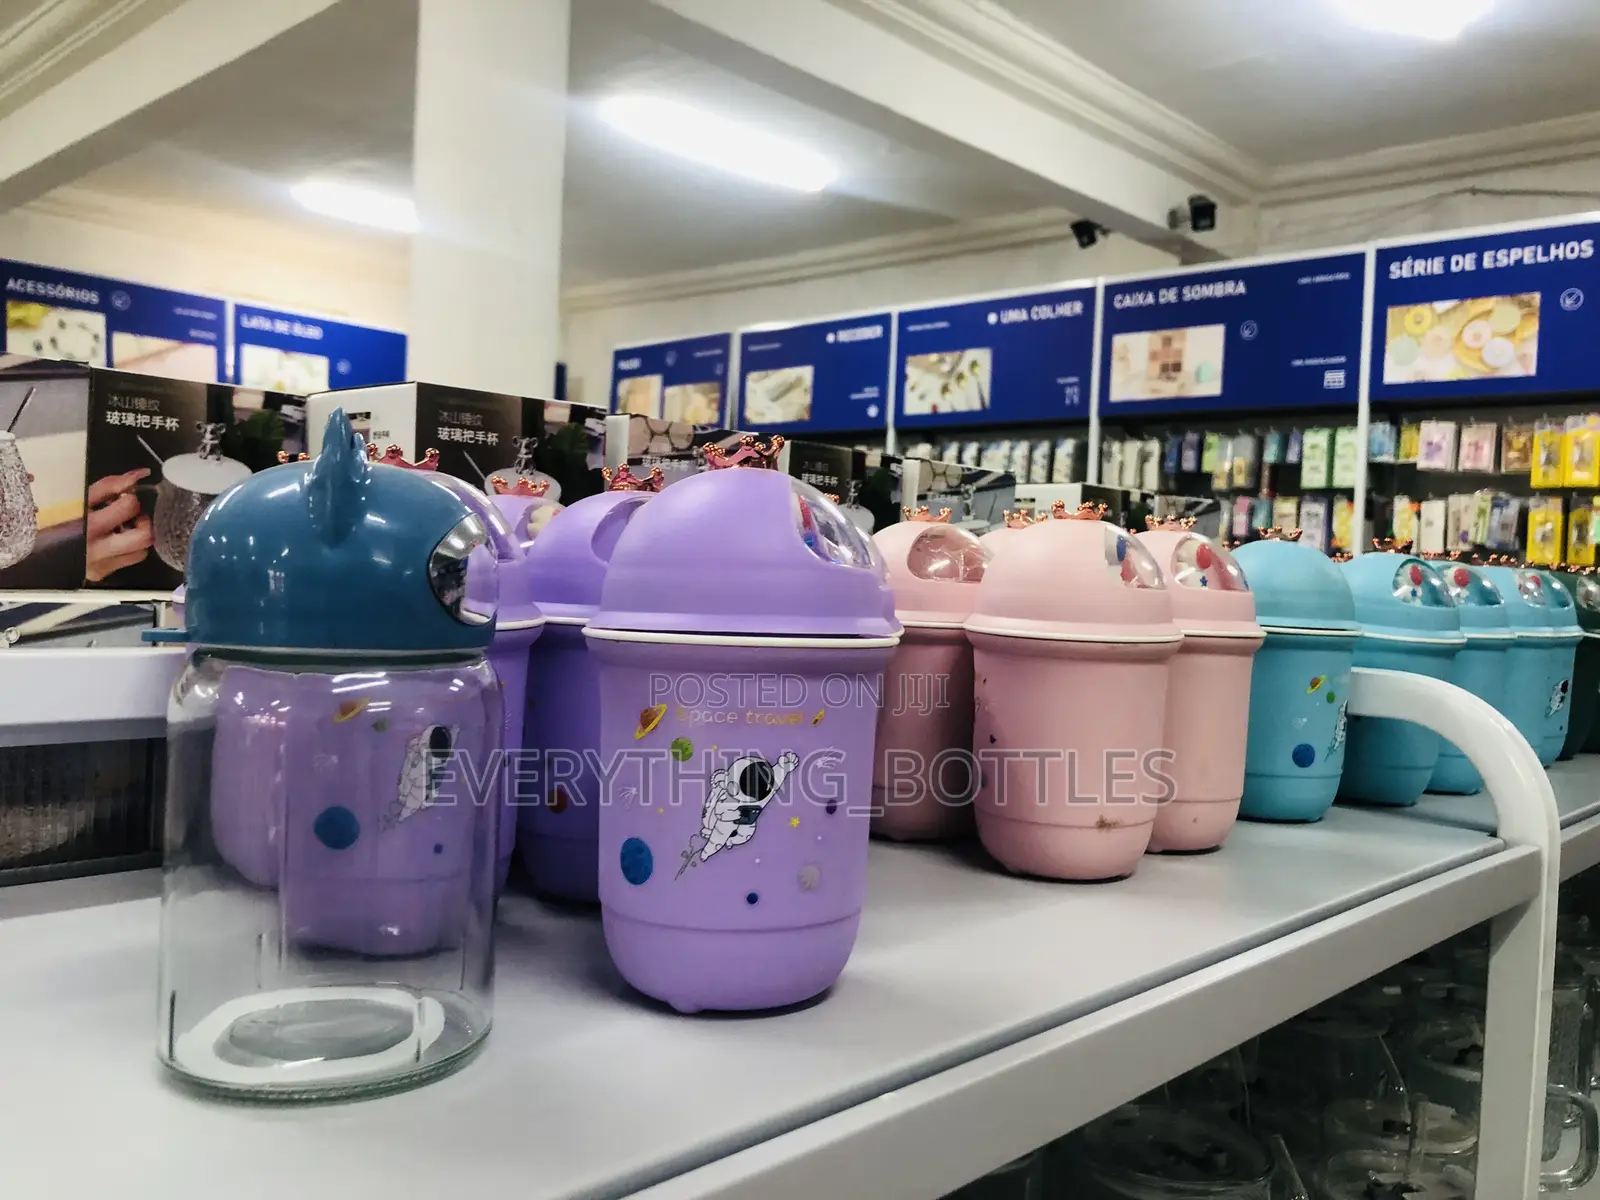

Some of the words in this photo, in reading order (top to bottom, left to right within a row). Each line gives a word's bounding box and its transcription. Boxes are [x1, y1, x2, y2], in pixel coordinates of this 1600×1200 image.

[1389, 255, 1446, 280] SÉRIE
[1449, 251, 1478, 274] DE
[1482, 238, 1595, 270] ESPELHOS
[6, 277, 100, 305] ACESSÓRIOS
[1113, 290, 1156, 310] CAIXA
[1158, 286, 1179, 304] DE
[1181, 279, 1246, 302] SOMBRA
[105, 410, 180, 432] 玻璃把手杯
[437, 426, 500, 446] 玻璃把手杯
[745, 708, 804, 727] travel
